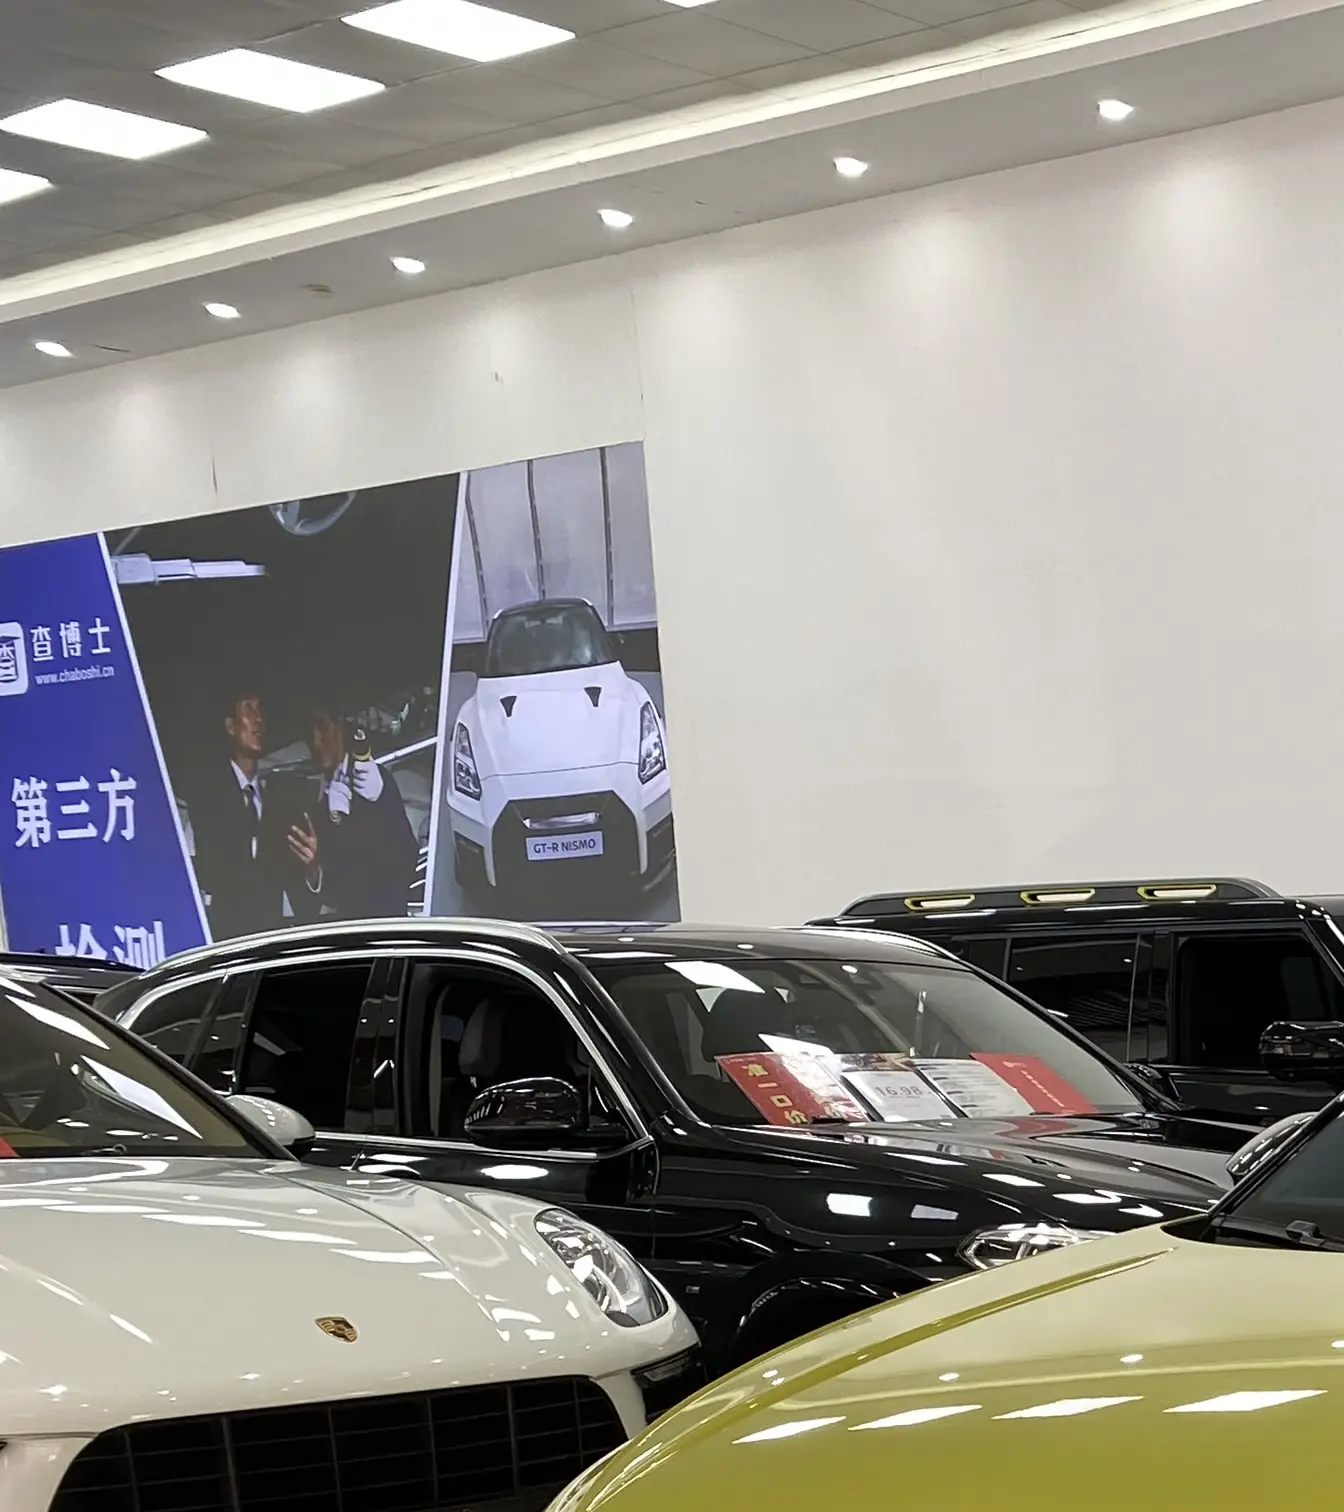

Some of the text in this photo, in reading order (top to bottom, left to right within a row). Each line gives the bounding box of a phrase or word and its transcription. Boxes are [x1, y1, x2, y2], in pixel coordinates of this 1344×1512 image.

[30, 617, 111, 662] 查博士
[35, 664, 115, 685] www.chaboshi.cn
[11, 769, 137, 848] 第三方
[533, 838, 596, 854] GT-R NISMO
